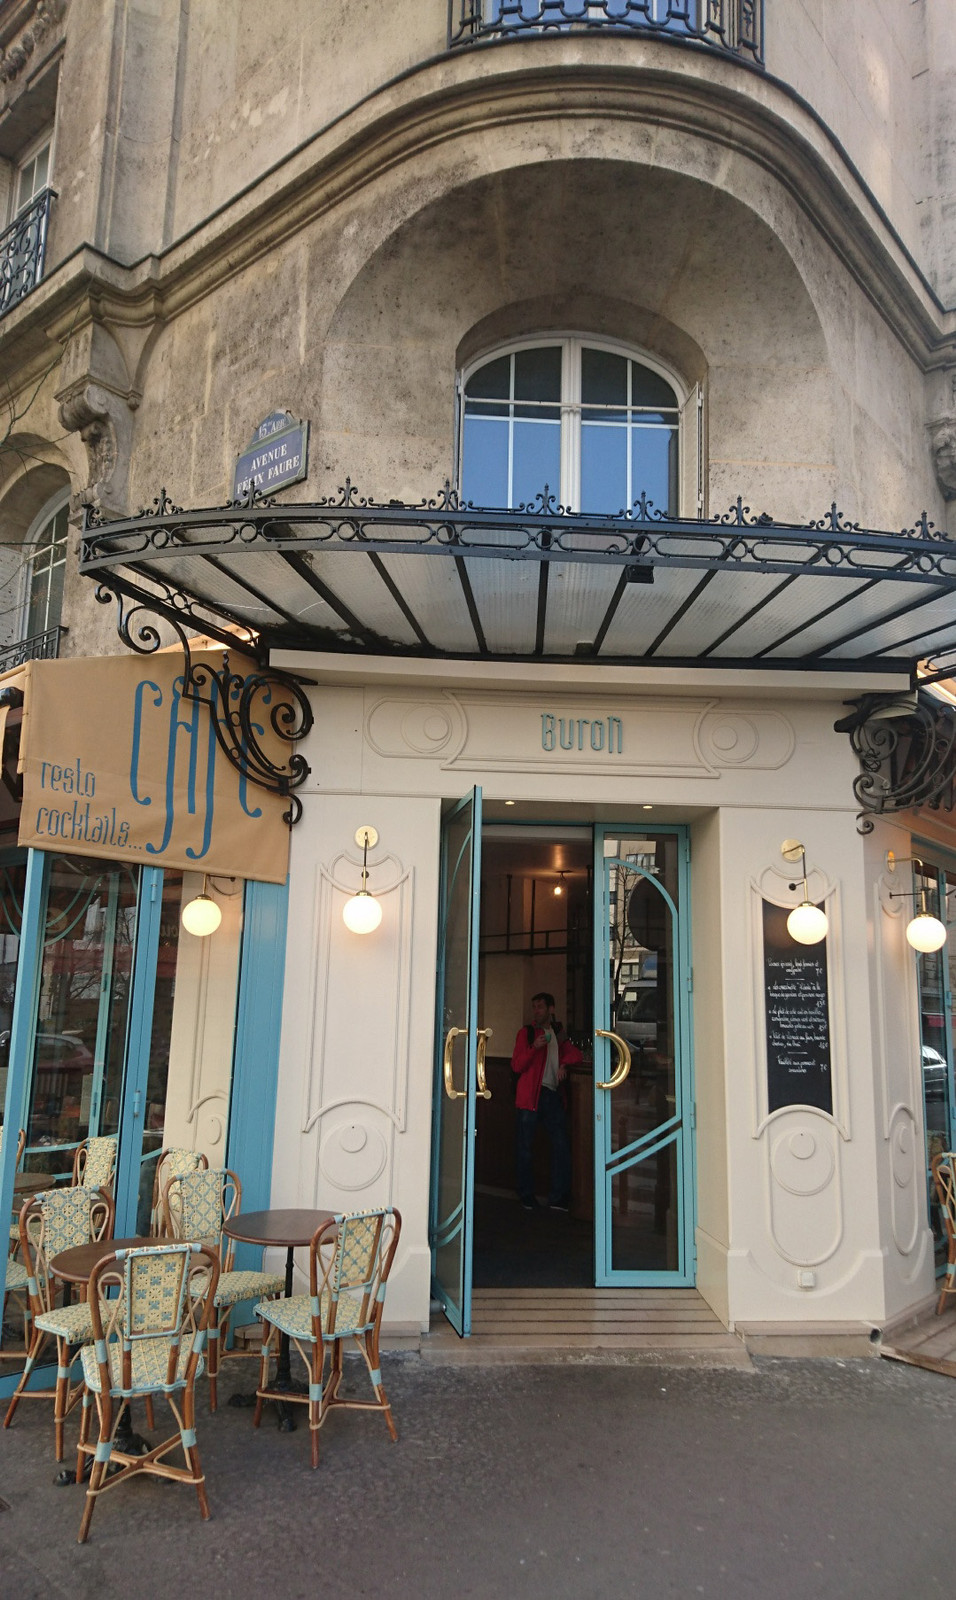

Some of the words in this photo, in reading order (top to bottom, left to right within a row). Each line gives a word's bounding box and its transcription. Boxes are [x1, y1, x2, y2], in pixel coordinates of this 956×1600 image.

[250, 443, 288, 472] AVENUE
[267, 454, 300, 480] FAURE
[41, 757, 96, 798] resto
